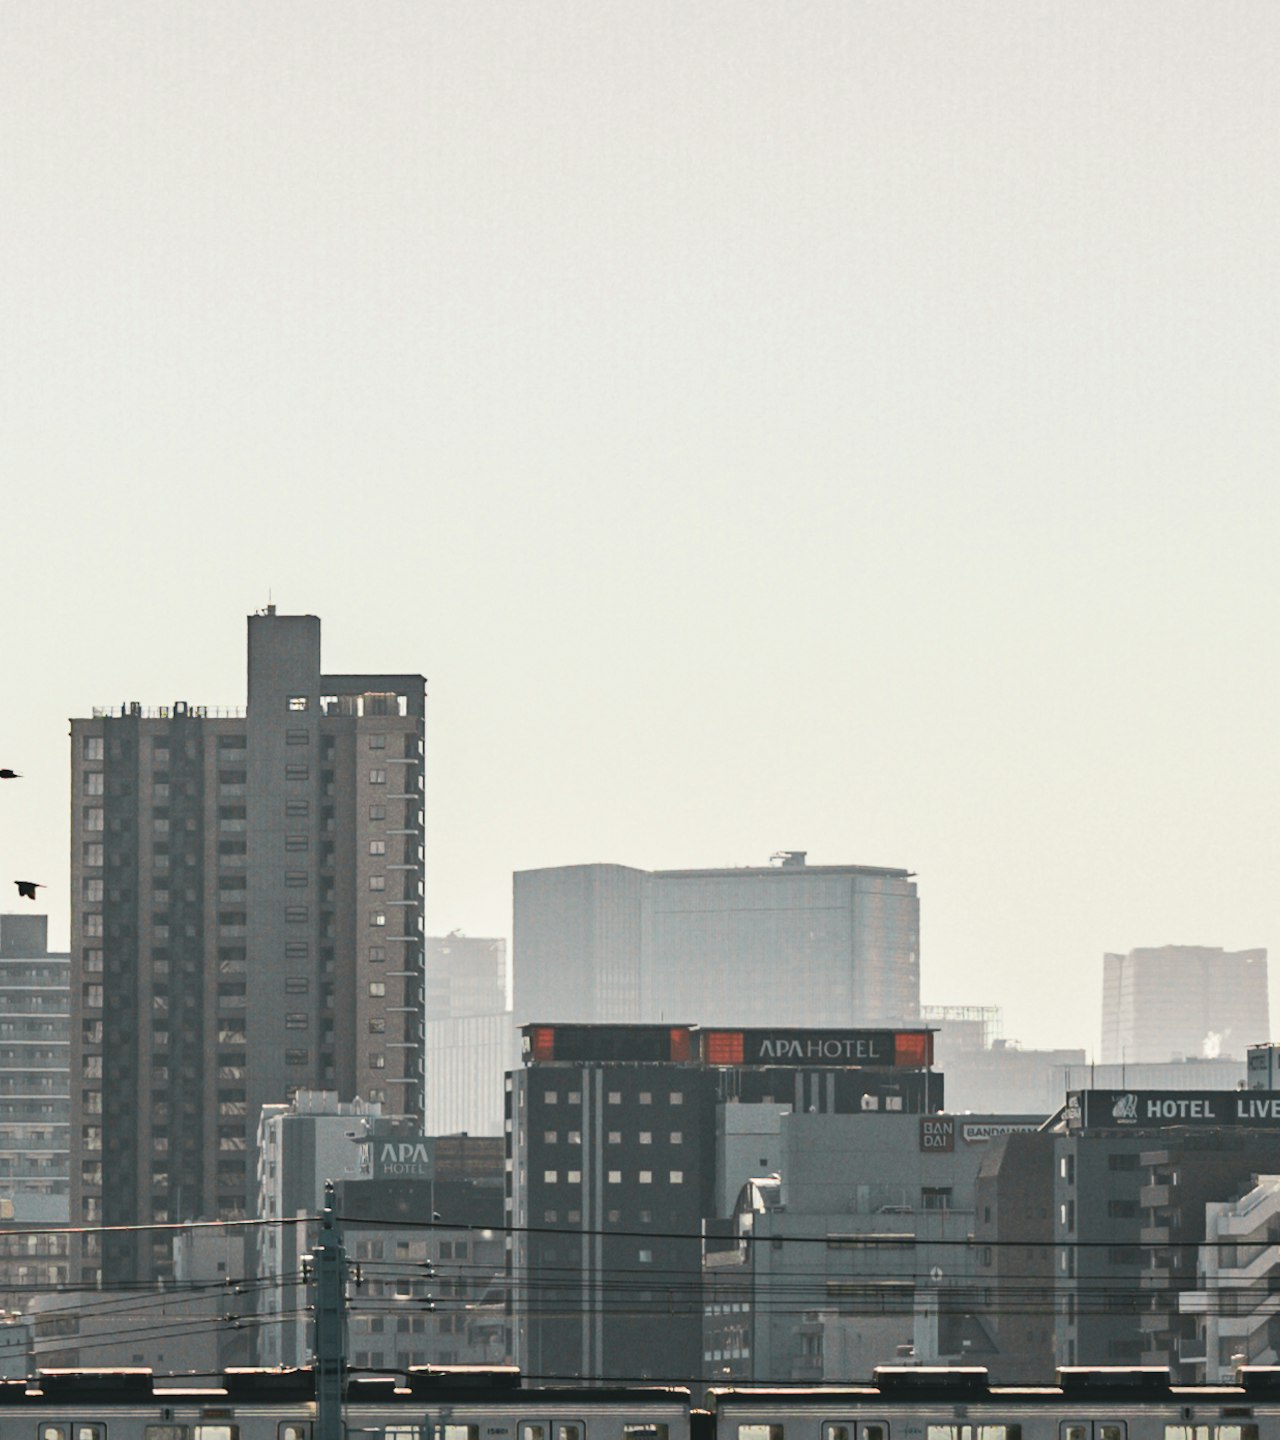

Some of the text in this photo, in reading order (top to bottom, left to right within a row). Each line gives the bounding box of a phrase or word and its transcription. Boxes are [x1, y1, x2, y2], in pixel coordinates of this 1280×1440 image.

[759, 1039, 881, 1058] APA HOTEL
[1147, 1099, 1216, 1118] HOTEL
[923, 1122, 953, 1134] BAN
[923, 1135, 947, 1147] DAI
[380, 1142, 430, 1163] APA
[383, 1163, 425, 1175] HOTEL
